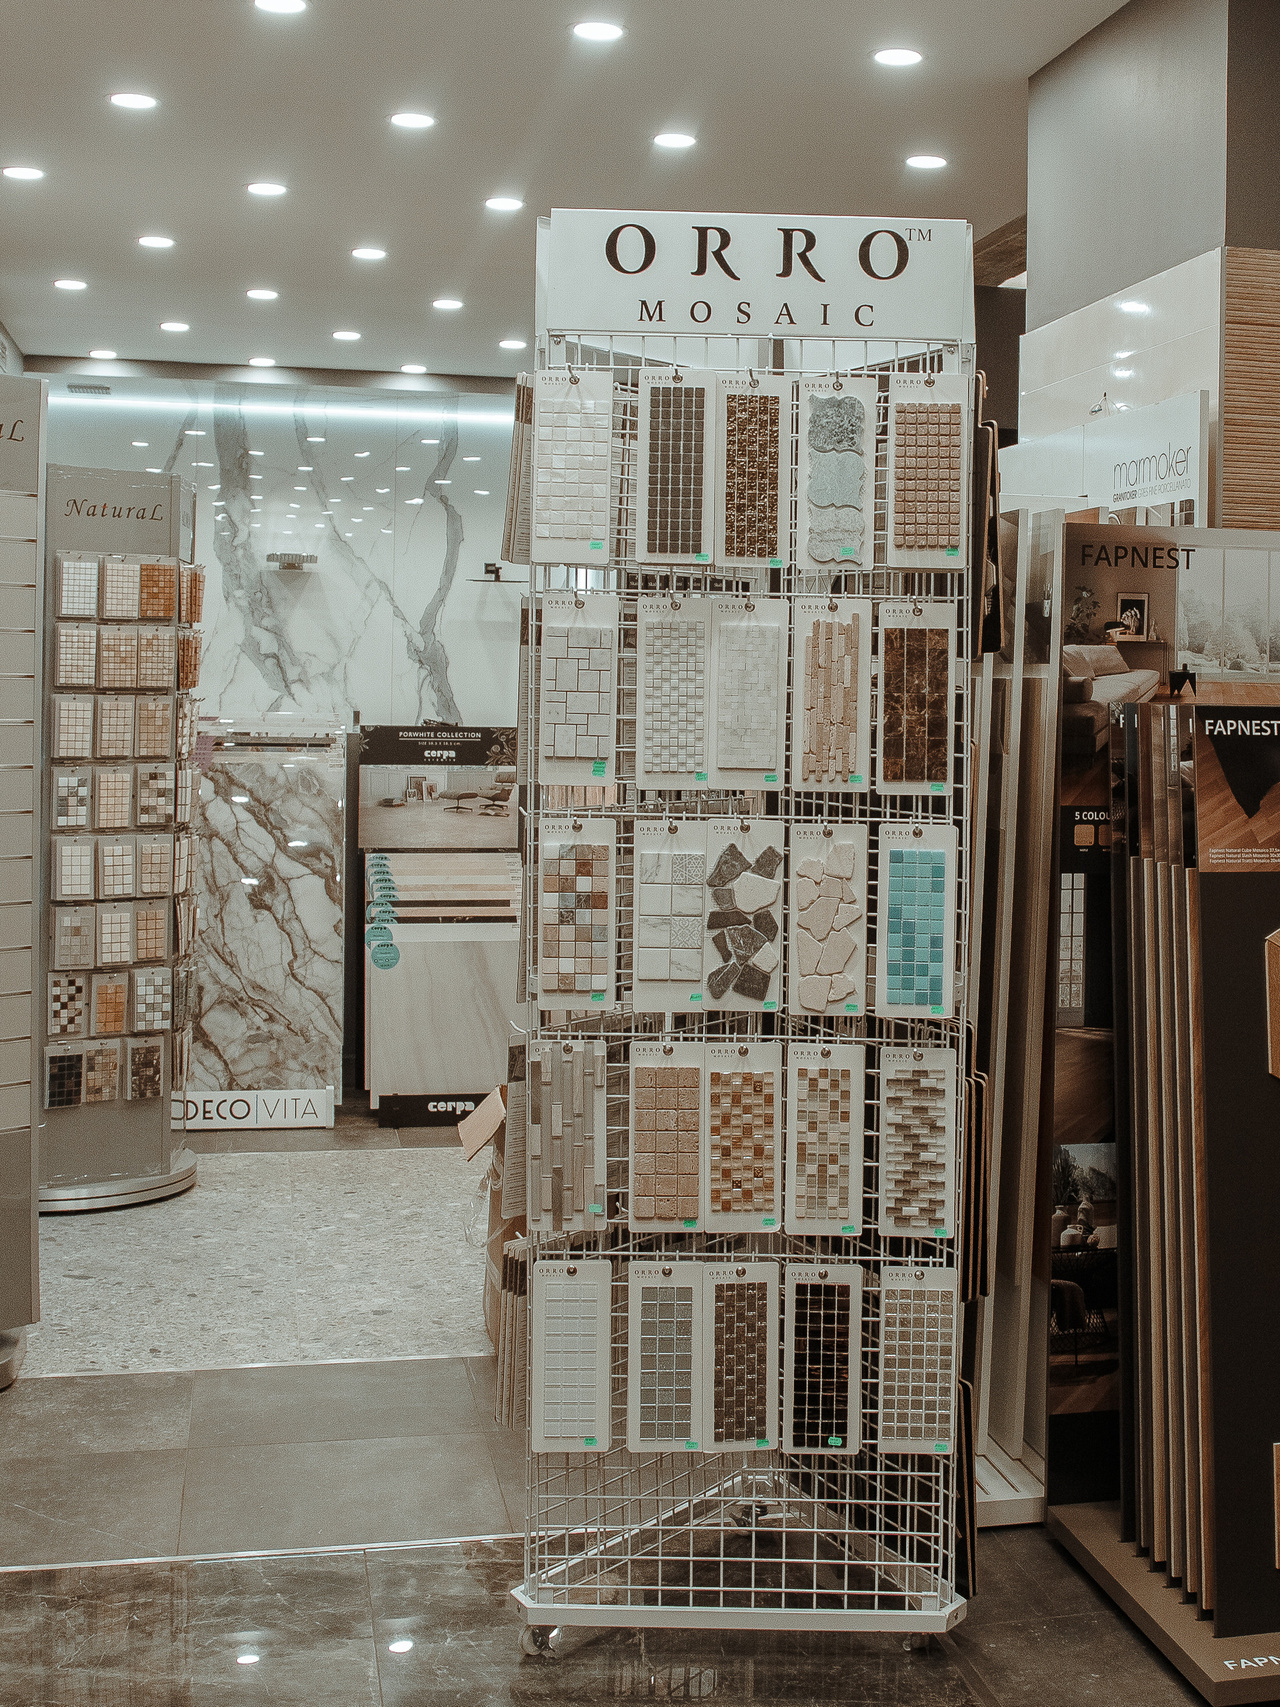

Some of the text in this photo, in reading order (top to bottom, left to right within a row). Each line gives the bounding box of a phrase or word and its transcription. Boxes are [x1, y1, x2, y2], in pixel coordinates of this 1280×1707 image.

[605, 224, 910, 283] ORRO
[638, 299, 874, 327] MOSAIC
[1114, 442, 1192, 489] marmoker
[1081, 545, 1196, 570] FAPNEST
[1205, 720, 1280, 736] FAPNEST
[1075, 811, 1080, 820] 5
[186, 1098, 319, 1120] DECO VITA
[428, 1101, 474, 1114] cerpa
